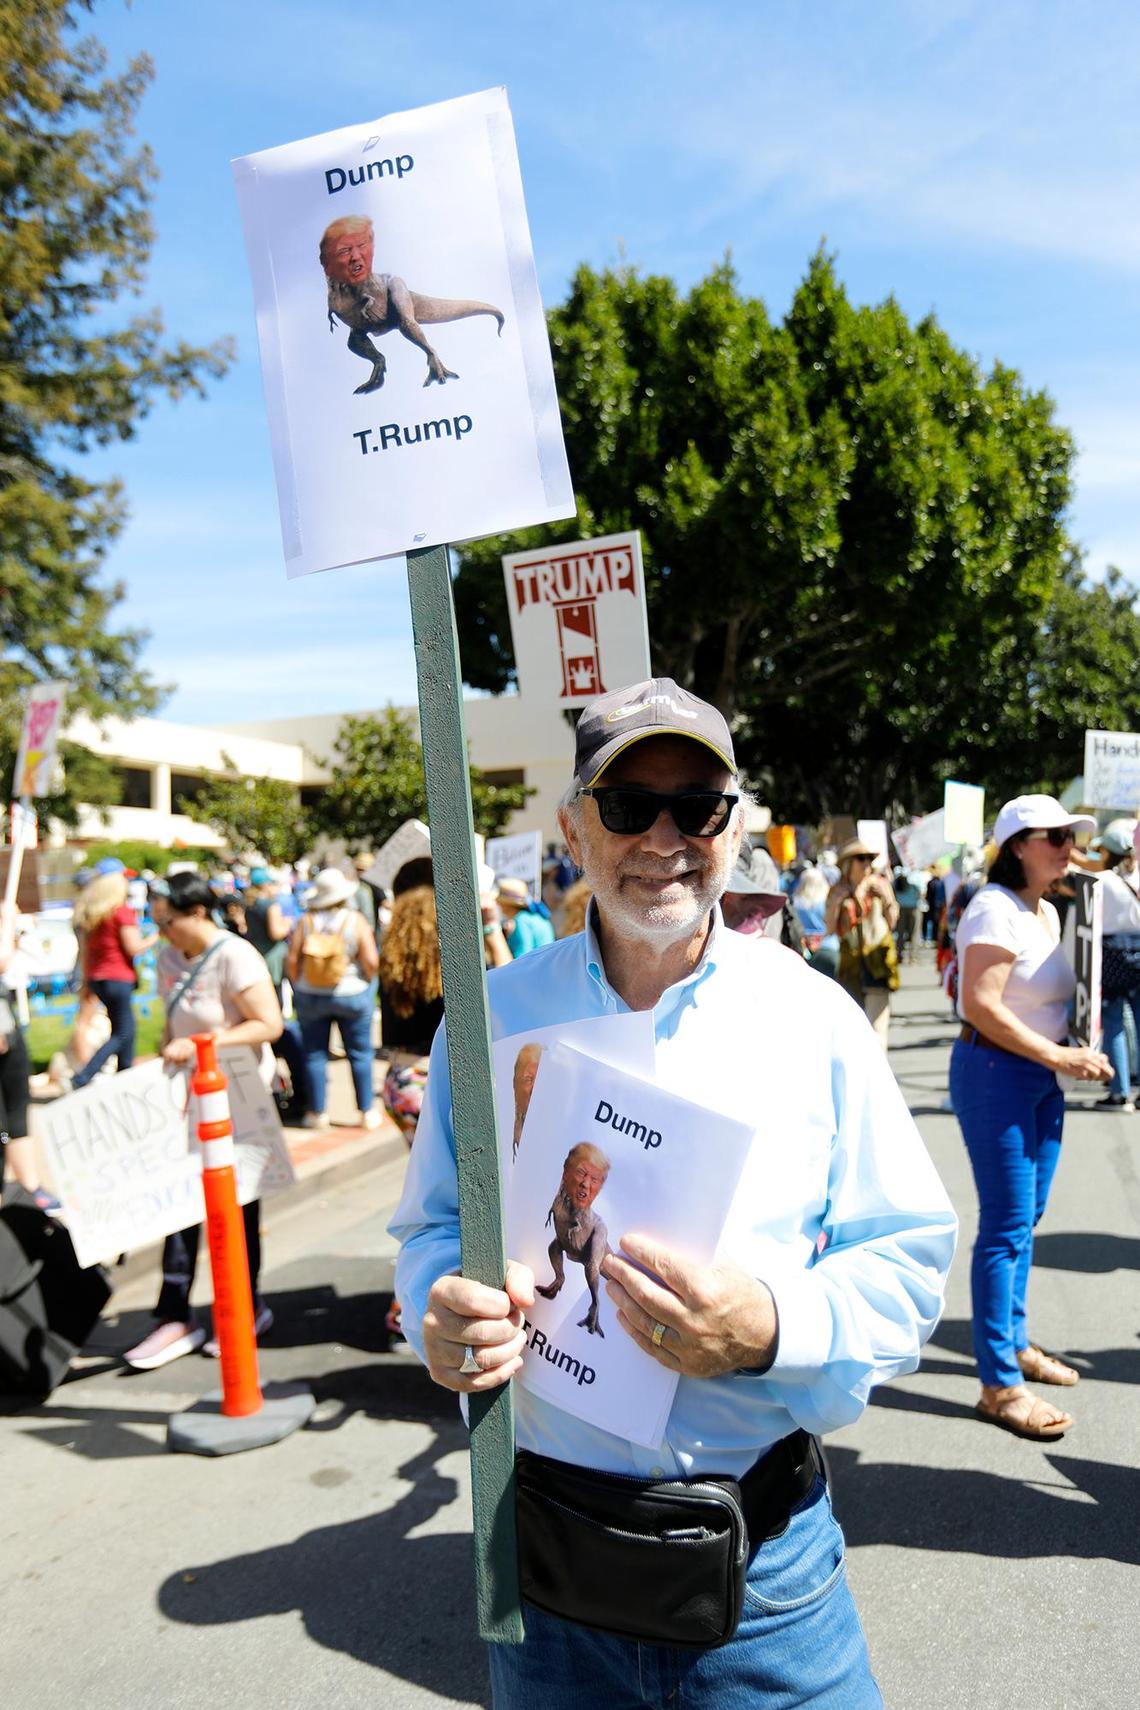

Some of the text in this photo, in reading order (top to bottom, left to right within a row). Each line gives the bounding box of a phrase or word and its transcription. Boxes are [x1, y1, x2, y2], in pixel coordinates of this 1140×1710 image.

[324, 154, 415, 196] Dump
[352, 414, 473, 455] T.Rump
[514, 551, 634, 605] TRUMP
[47, 1083, 168, 1170] HANDS
[593, 1099, 663, 1150] Dump
